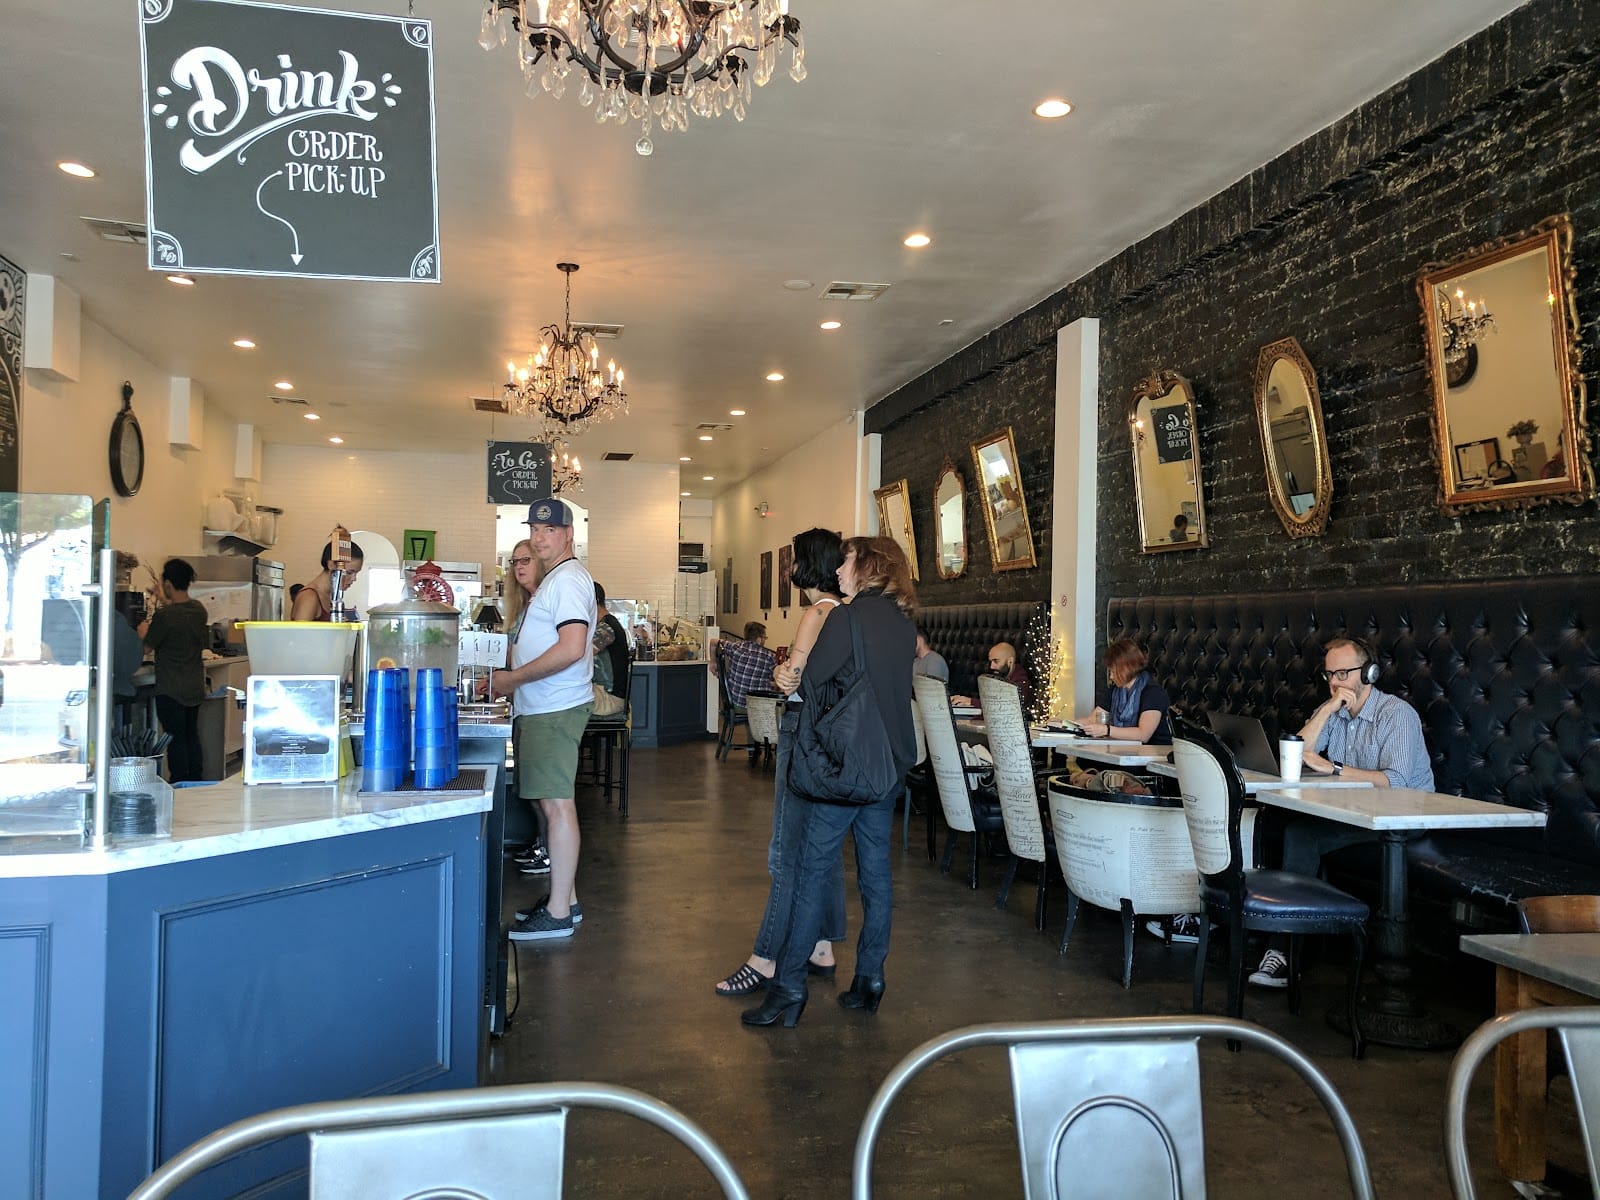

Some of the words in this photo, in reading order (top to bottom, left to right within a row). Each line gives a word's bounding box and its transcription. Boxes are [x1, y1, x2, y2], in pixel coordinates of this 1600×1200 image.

[171, 46, 379, 138] Drink
[287, 130, 384, 162] ORDER
[285, 162, 387, 199] PICK-UP
[495, 450, 515, 469] To
[519, 450, 538, 469] Go
[511, 470, 538, 480] ORDER
[512, 480, 539, 489] PICK-UP
